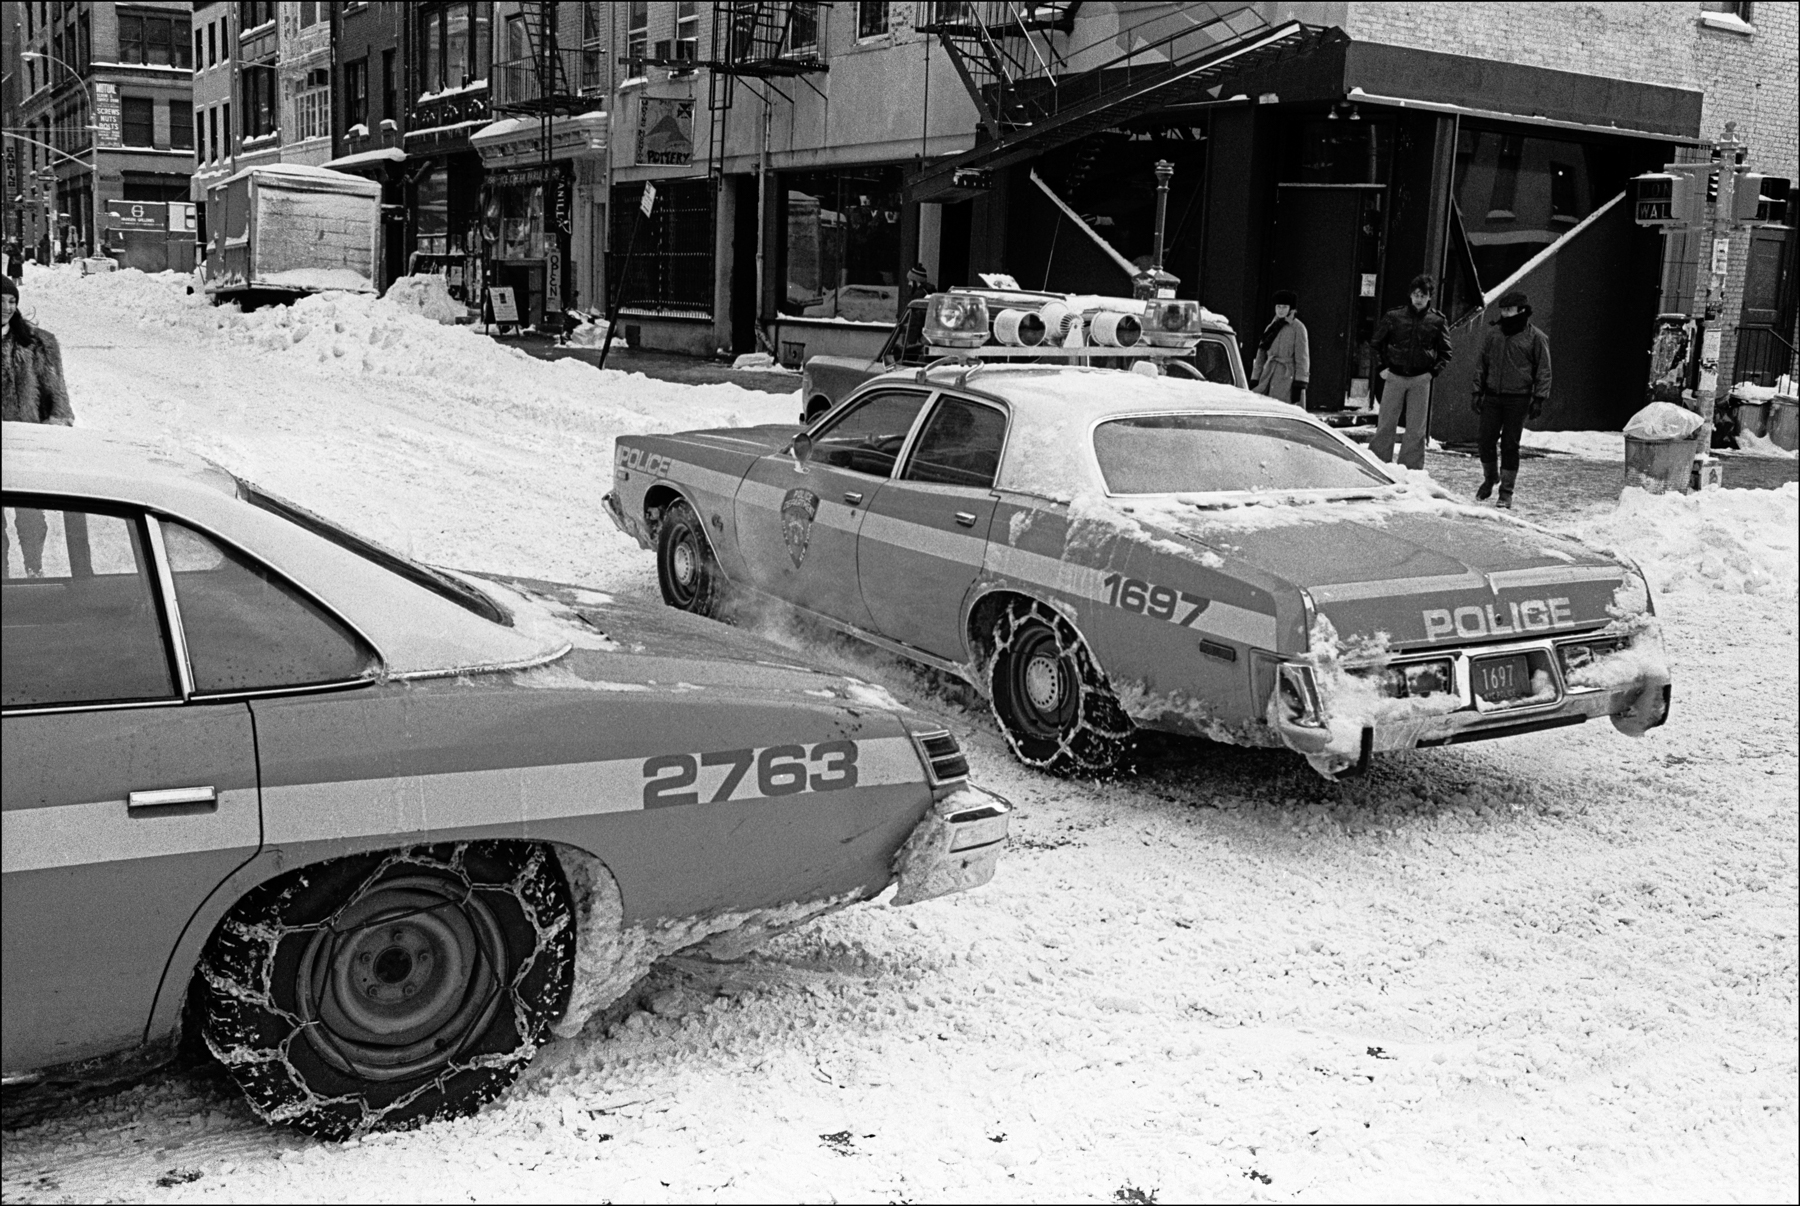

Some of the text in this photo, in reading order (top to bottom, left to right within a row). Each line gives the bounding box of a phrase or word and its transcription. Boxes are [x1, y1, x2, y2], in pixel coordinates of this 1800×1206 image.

[97, 107, 120, 116] SCREWS
[98, 122, 119, 130] BOLTS
[647, 150, 690, 165] POTTERY
[1640, 204, 1669, 219] WAL
[549, 255, 559, 297] OPEN
[616, 445, 672, 478] POLICE
[1104, 573, 1211, 627] 1697
[1422, 597, 1575, 642] POLICE
[1482, 664, 1514, 690] 1697
[643, 740, 859, 810] 2763
